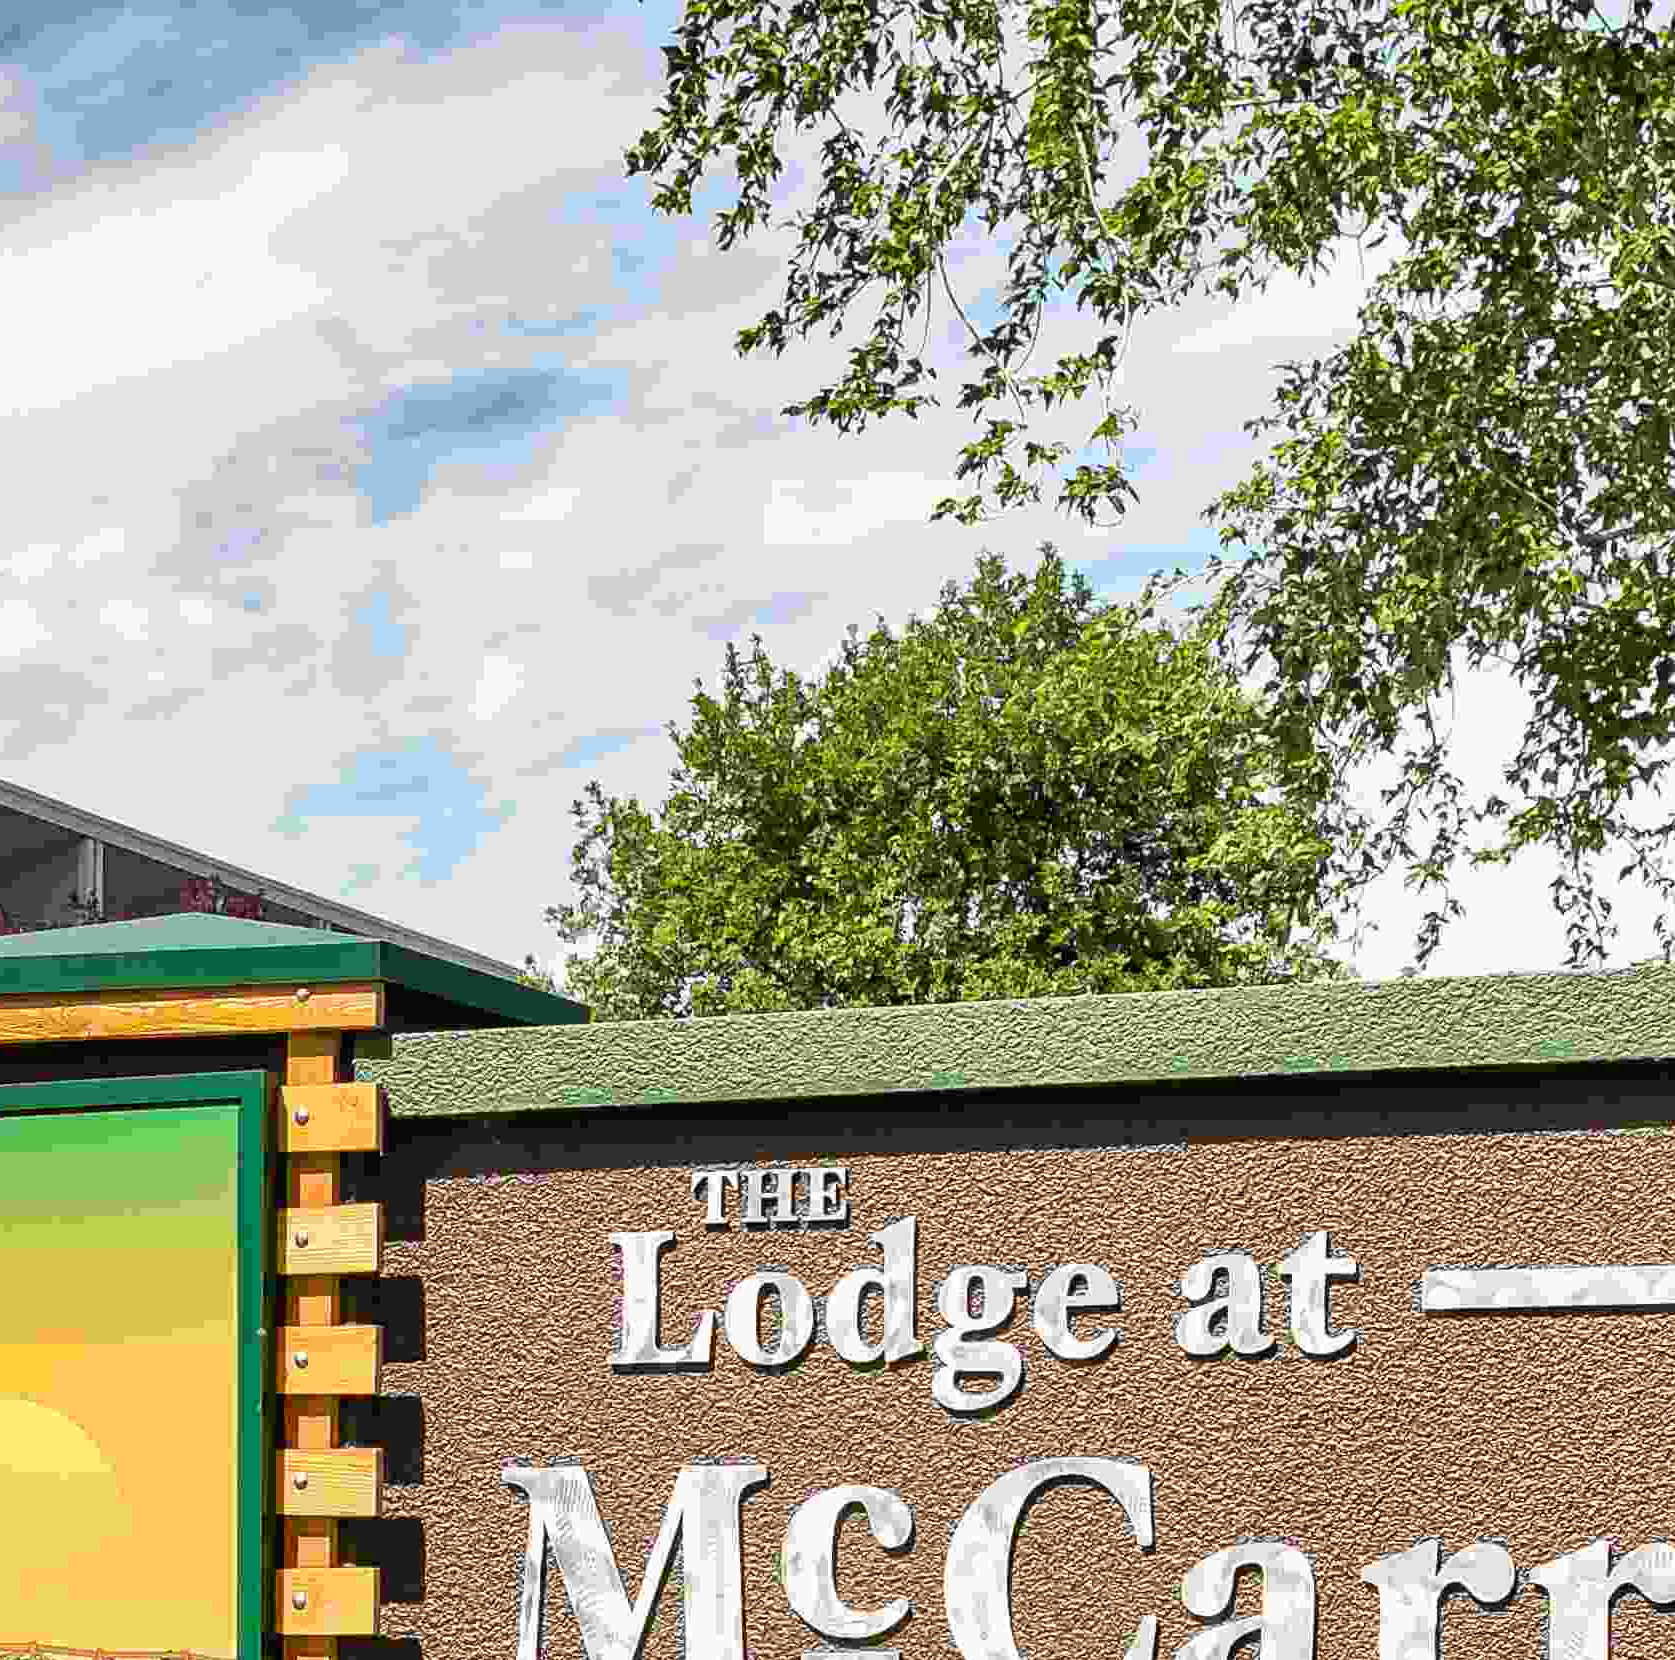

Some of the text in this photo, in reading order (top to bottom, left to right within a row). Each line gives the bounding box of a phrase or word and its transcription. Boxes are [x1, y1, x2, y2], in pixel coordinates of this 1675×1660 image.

[691, 1168, 851, 1229] THE
[610, 1215, 1360, 1418] Lodge at
